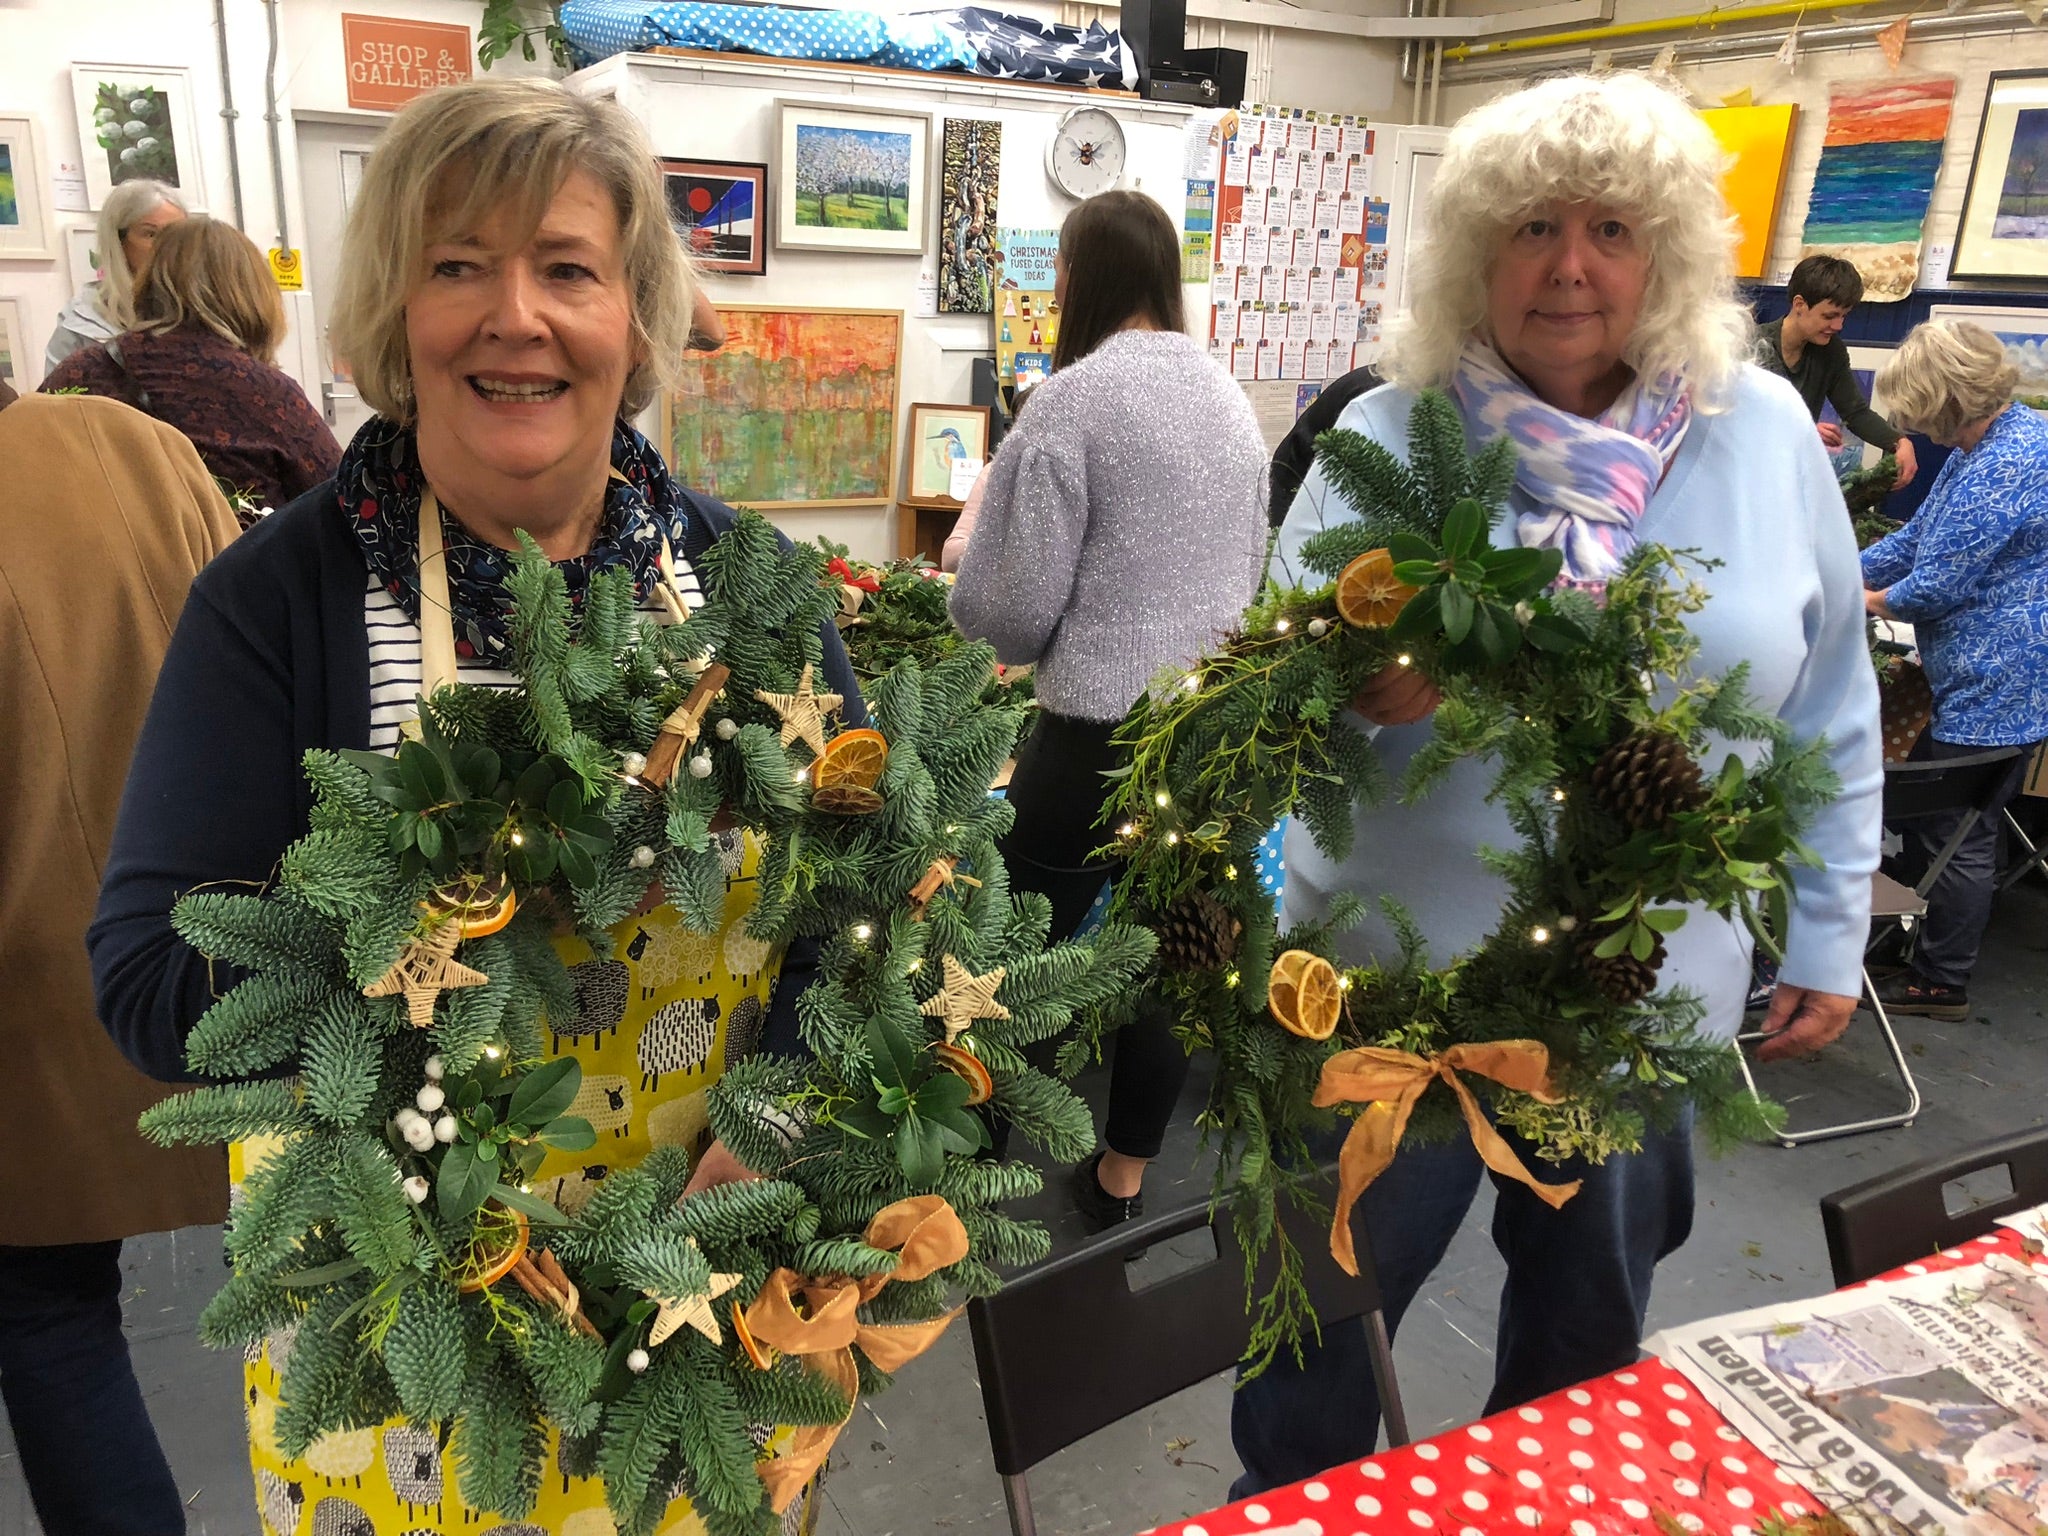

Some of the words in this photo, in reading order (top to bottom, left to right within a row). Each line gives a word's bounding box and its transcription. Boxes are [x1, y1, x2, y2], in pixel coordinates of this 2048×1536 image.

[362, 42, 428, 67] SHOP
[437, 49, 455, 70] &
[1010, 246, 1057, 259] CHRISTMAS
[1010, 259, 1032, 269] FUSED
[1024, 271, 1046, 280] IDEAS
[1024, 358, 1043, 367] KIDS
[1697, 1335, 1830, 1445] burden
[1818, 1436, 1856, 1464] a
